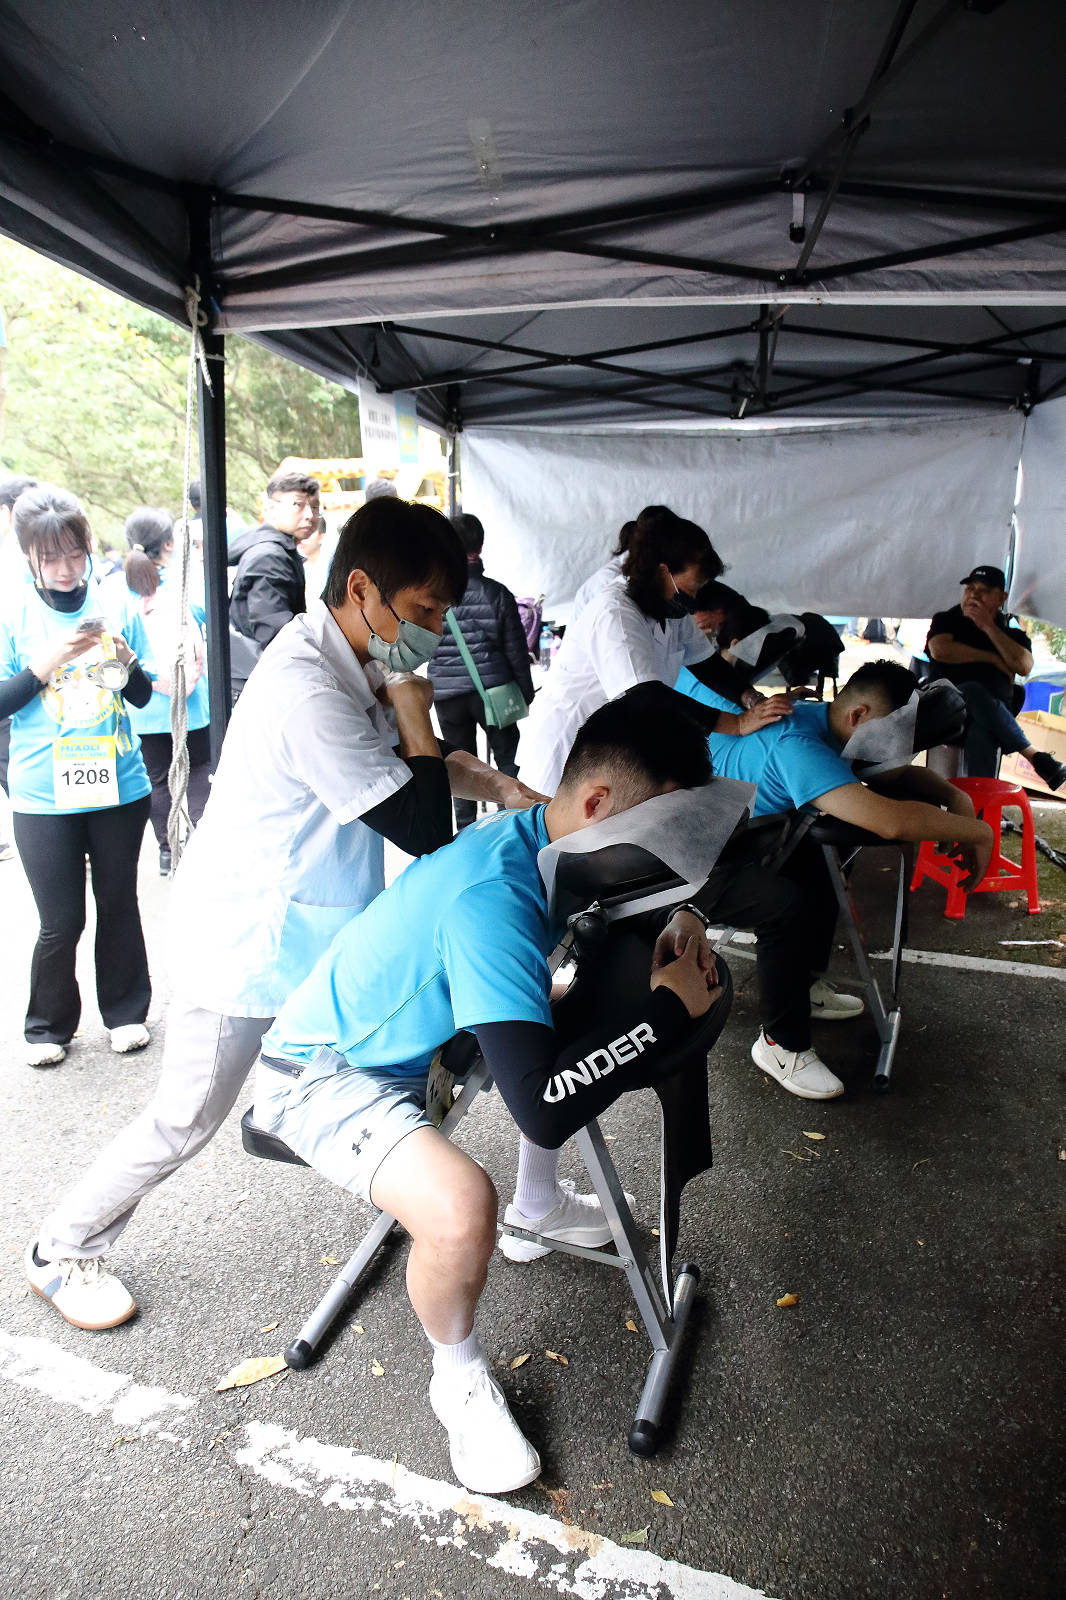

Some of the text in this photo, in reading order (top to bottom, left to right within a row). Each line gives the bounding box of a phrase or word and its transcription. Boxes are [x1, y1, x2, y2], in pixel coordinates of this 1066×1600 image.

[60, 744, 100, 752] MIAOLI
[62, 769, 110, 786] 1208
[543, 1022, 657, 1103] UNDER
